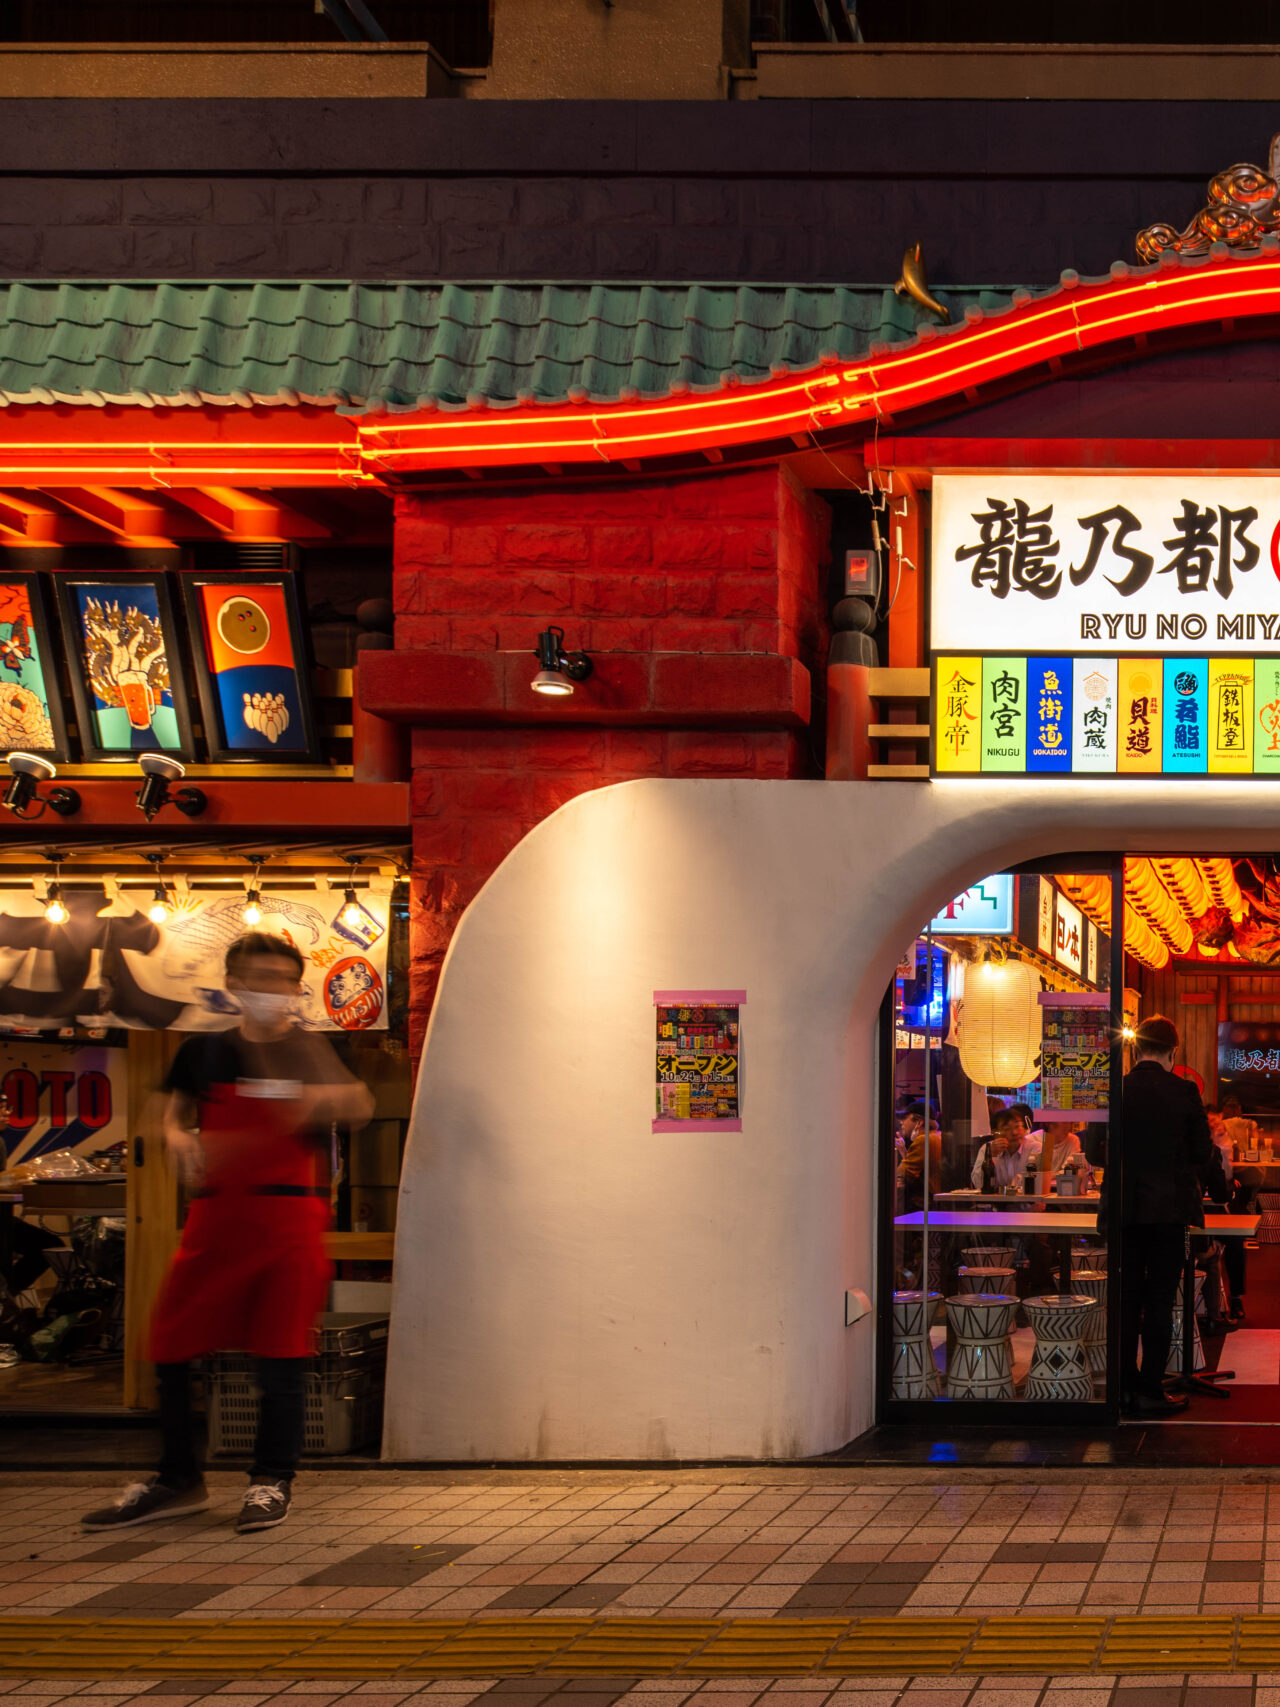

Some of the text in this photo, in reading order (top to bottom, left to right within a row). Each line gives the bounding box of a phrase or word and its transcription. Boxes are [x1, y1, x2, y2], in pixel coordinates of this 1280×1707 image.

[955, 497, 1260, 600] 龍乃都
[1081, 613, 1147, 640] RYU
[1156, 613, 1208, 640] NO
[942, 670, 979, 757] 金豚帝
[990, 670, 1021, 739] 肉宮
[1038, 670, 1063, 748] 魚街道
[1083, 706, 1108, 749] 肉蔵
[1126, 696, 1152, 755] 貝道
[987, 748, 1020, 757] NIKUGU
[657, 1055, 738, 1076] オープン
[1043, 1051, 1110, 1071] オープン
